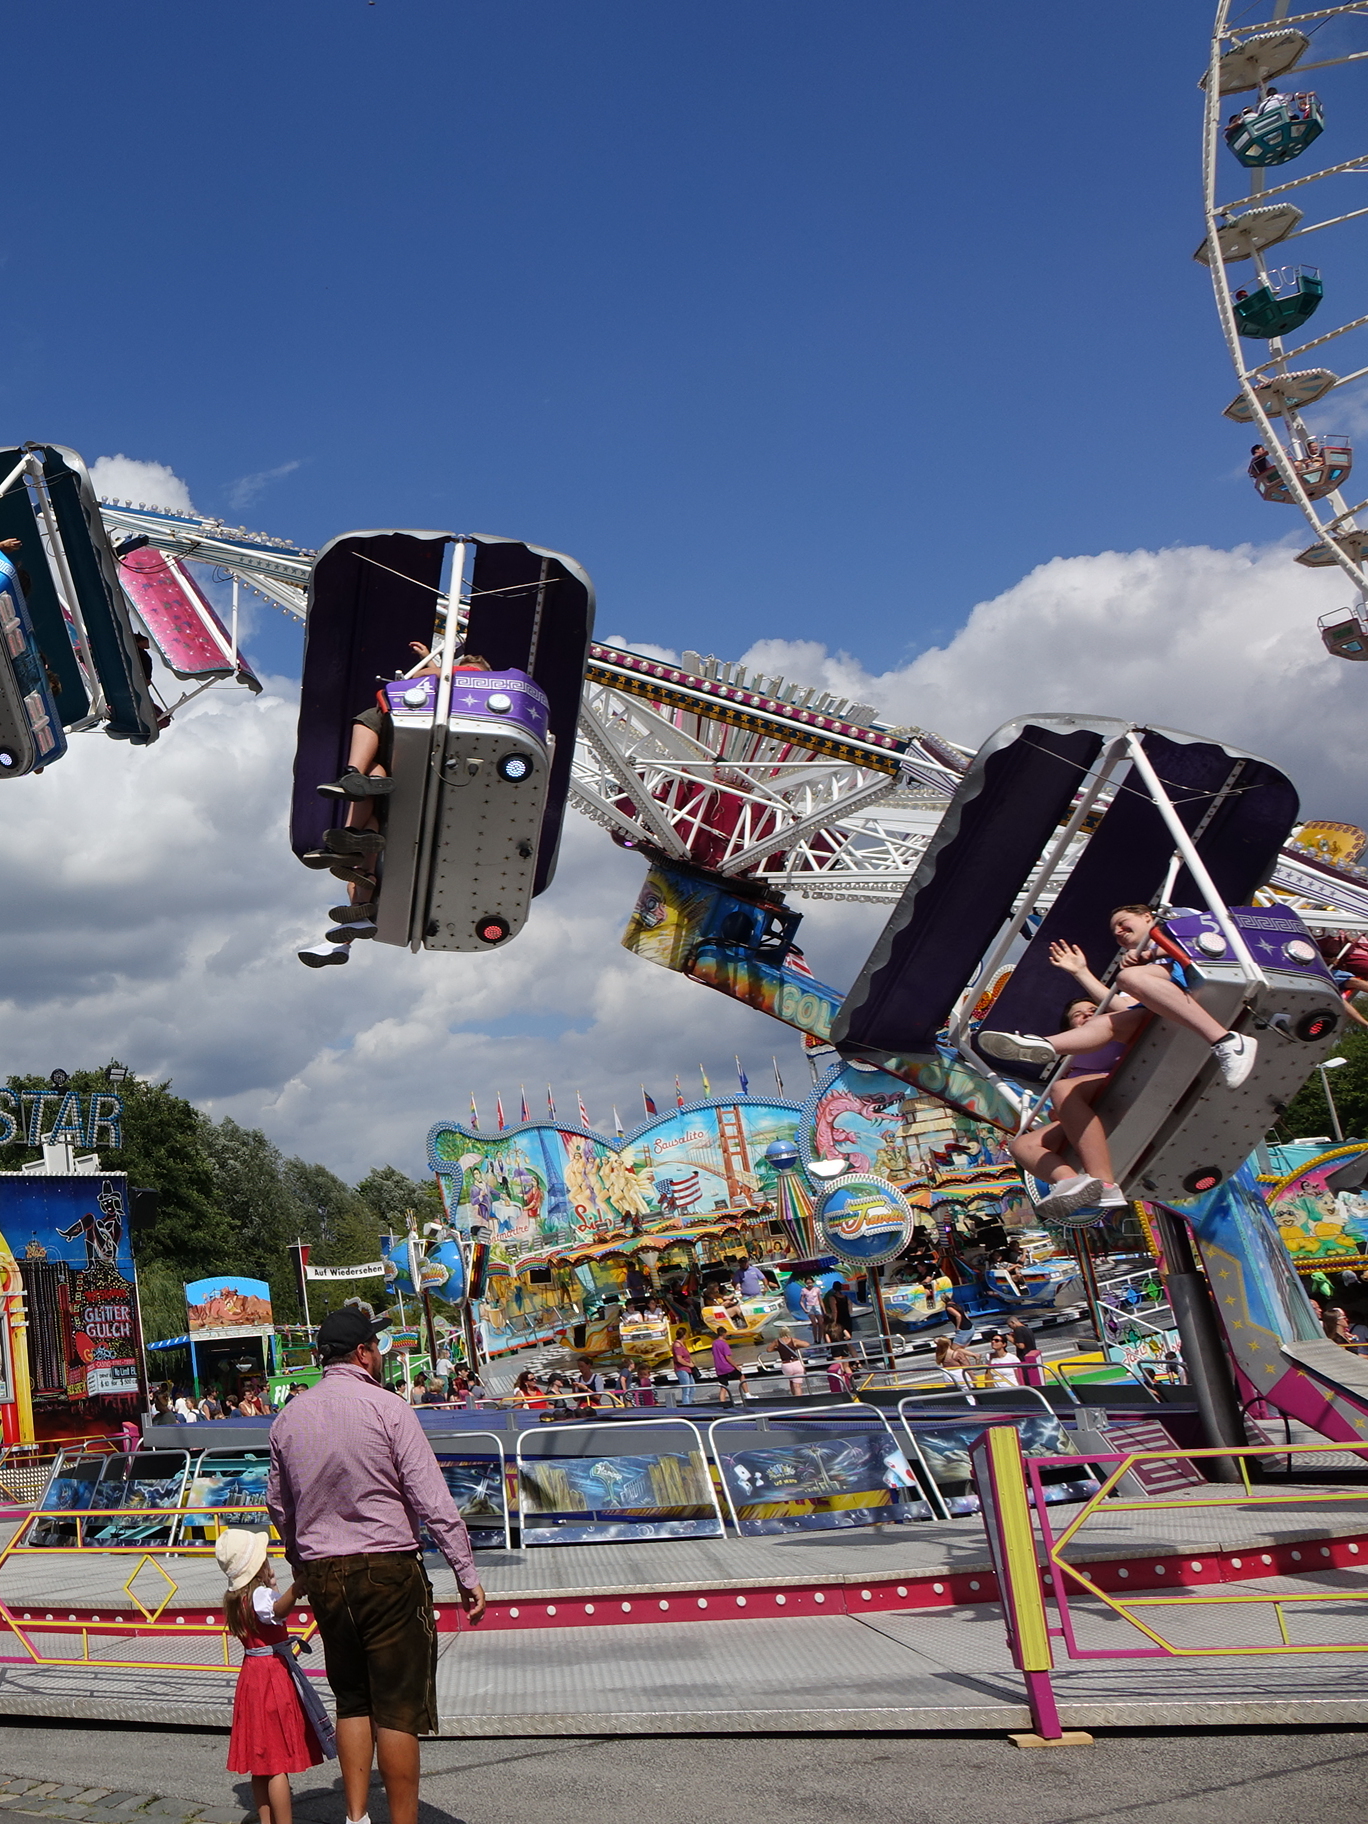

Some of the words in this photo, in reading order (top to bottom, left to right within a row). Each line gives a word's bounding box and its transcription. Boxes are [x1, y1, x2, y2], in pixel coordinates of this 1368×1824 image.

[416, 677, 434, 692] 4
[1200, 915, 1220, 933] 5
[653, 1130, 705, 1155] Sausalito
[488, 1225, 530, 1242] ontmartre
[314, 1268, 327, 1277] Auf
[329, 1265, 383, 1277] Wiedersehen
[86, 1322, 130, 1338] GULCH
